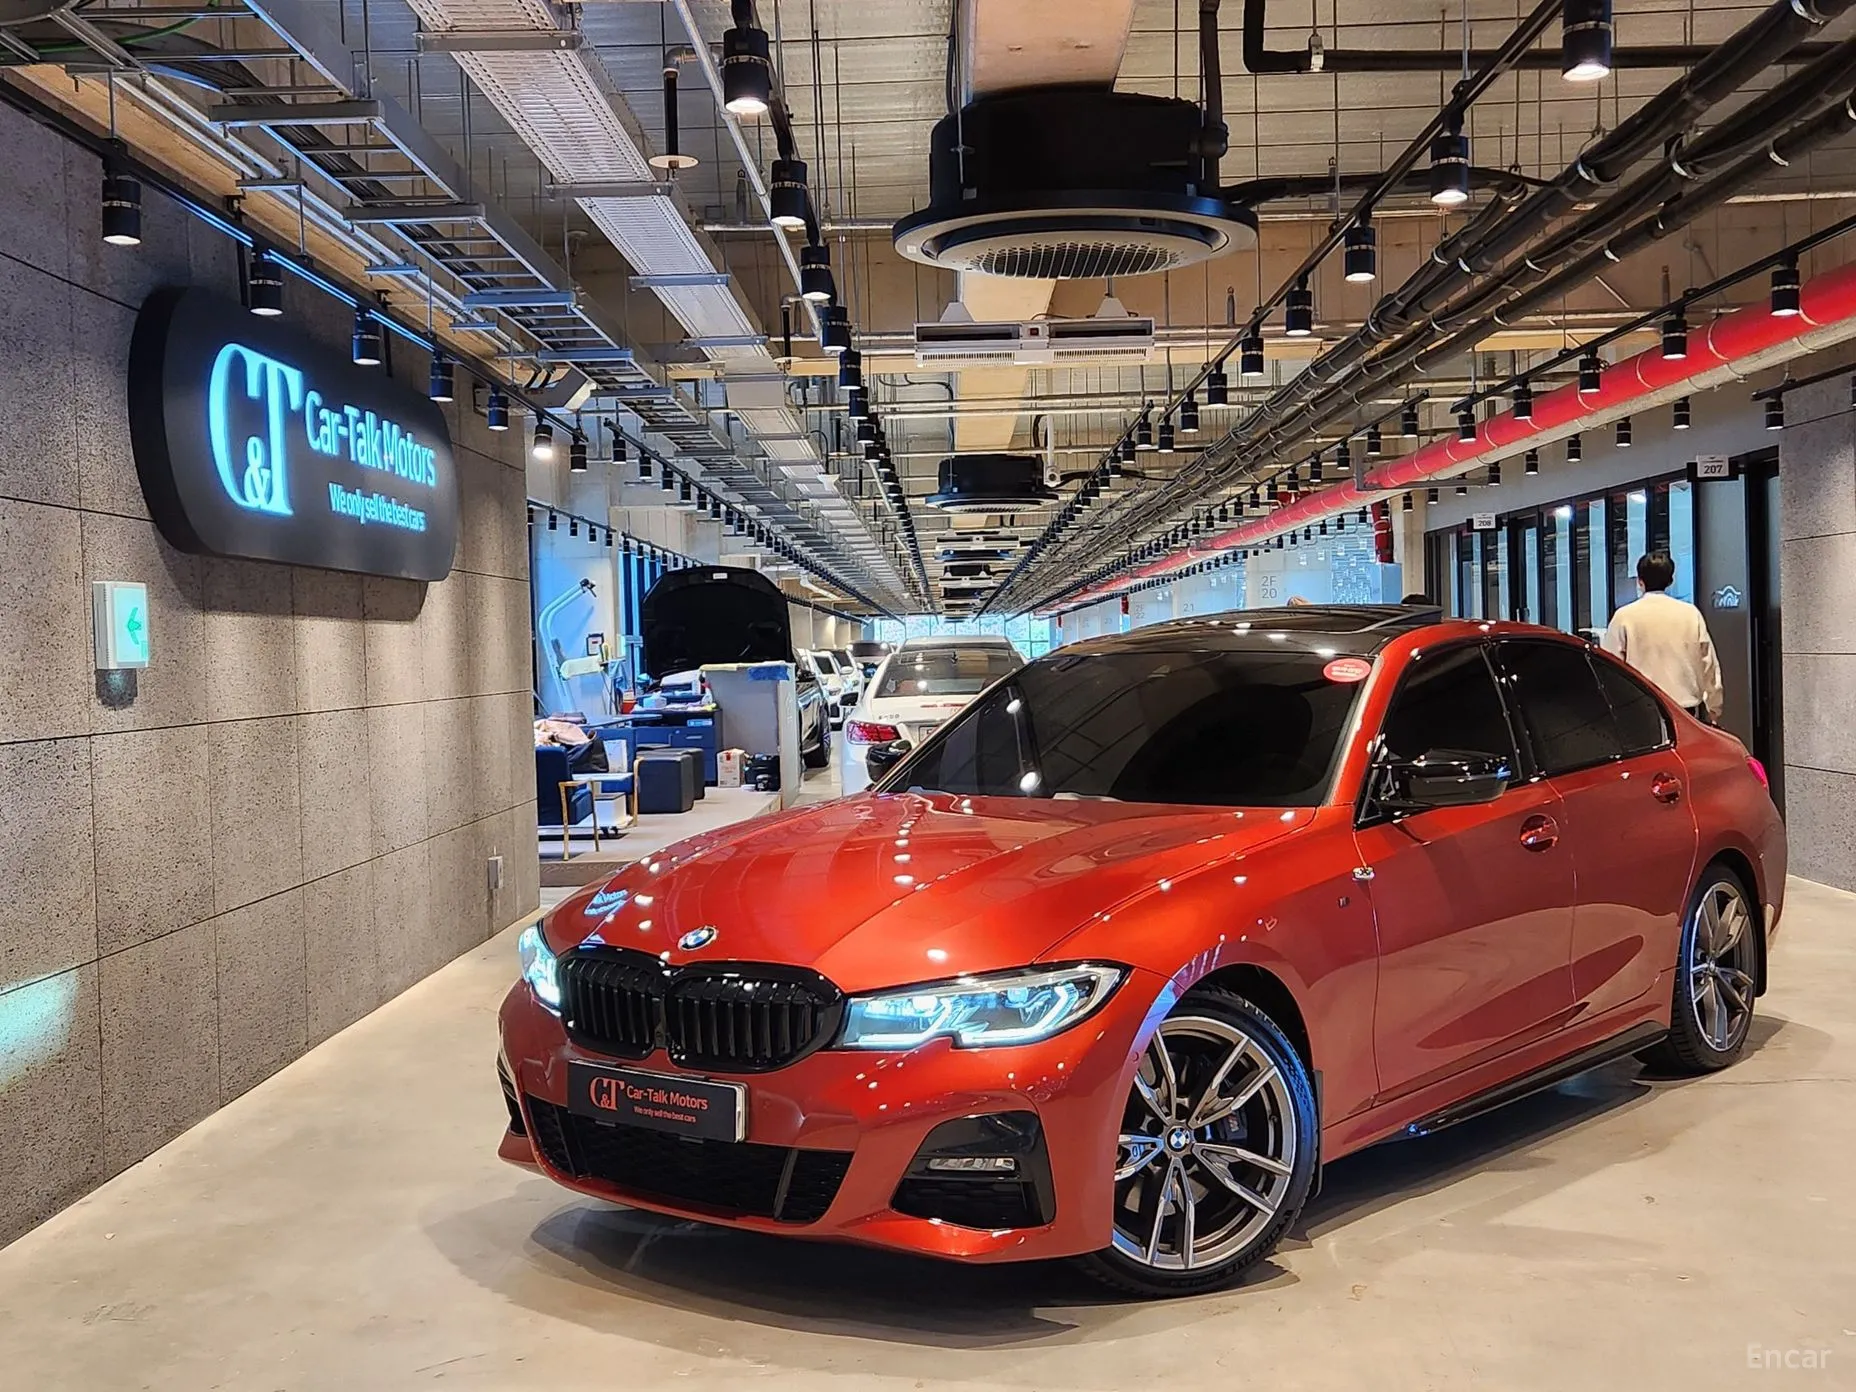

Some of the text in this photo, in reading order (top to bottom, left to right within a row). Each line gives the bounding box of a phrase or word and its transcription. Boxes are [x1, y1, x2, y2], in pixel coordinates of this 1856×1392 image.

[305, 390, 436, 487] Car-Talk Motors
[1703, 464, 1723, 475] 207
[329, 482, 427, 532] We only sell the best cars
[1261, 575, 1277, 587] 2F
[1261, 588, 1278, 599] 20
[626, 1085, 708, 1110] Car-Talk Motors
